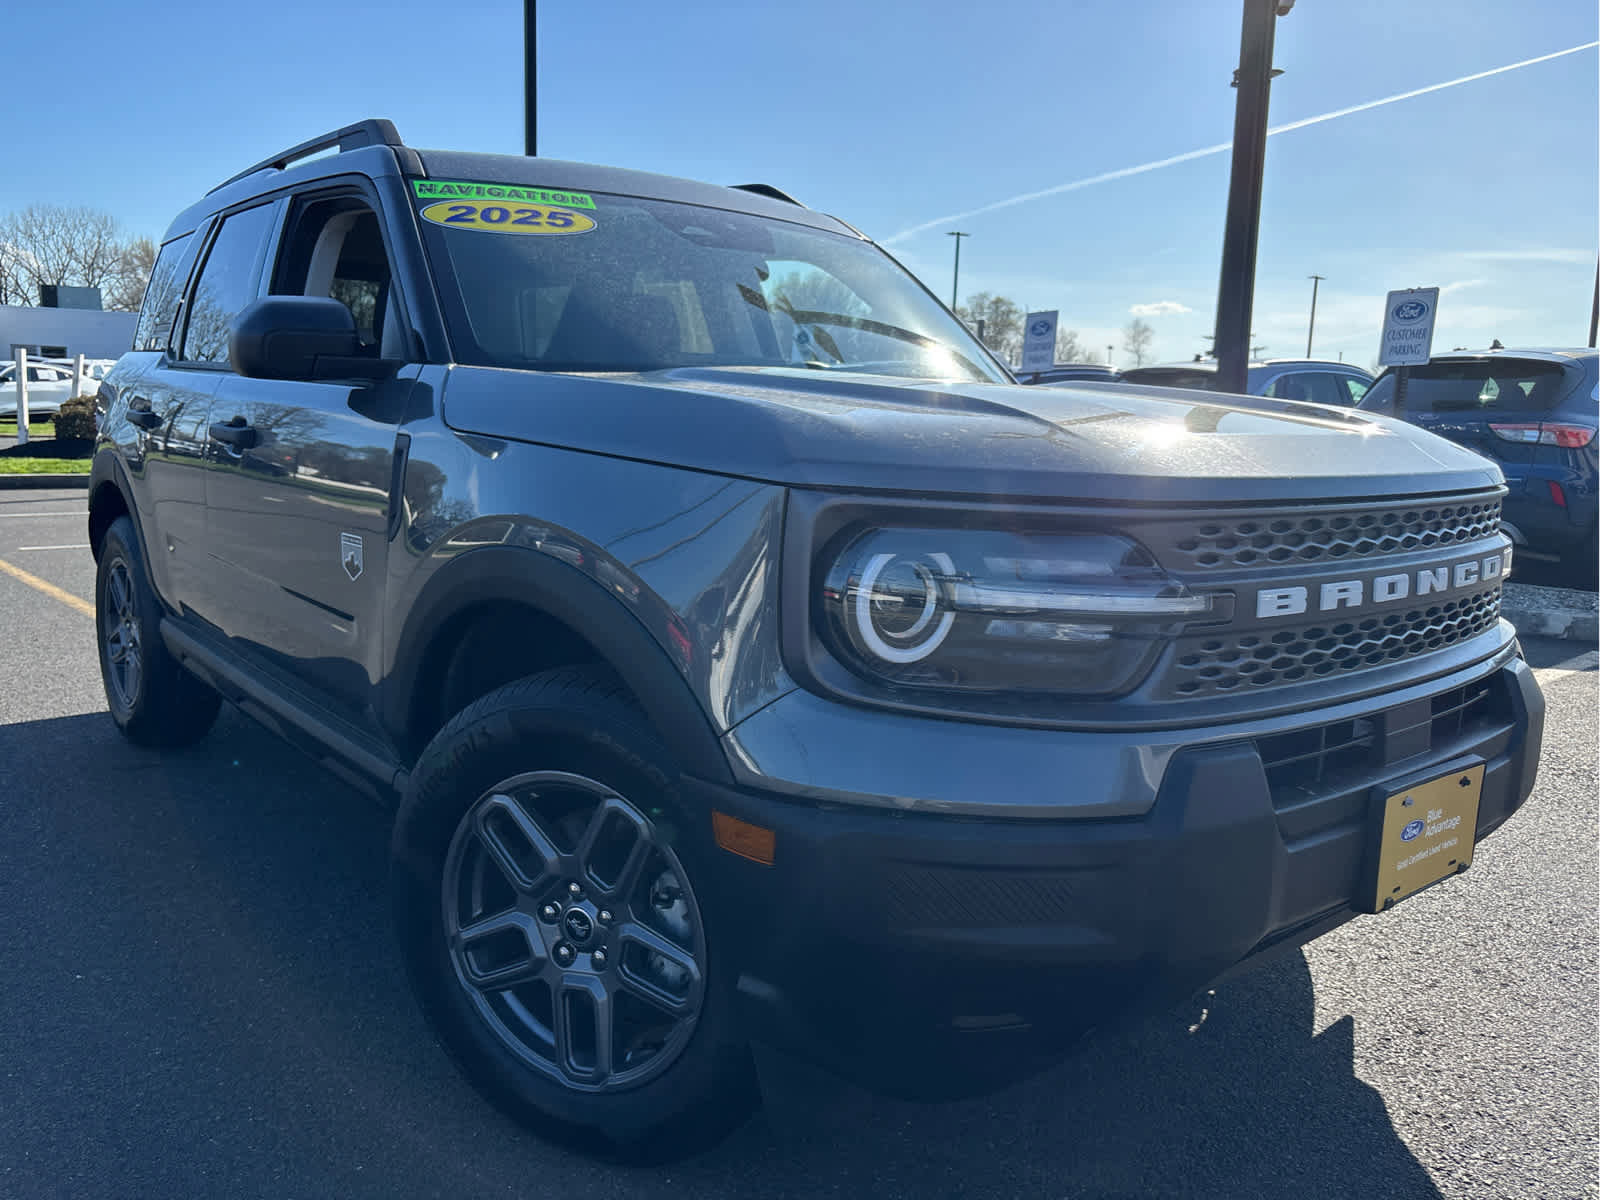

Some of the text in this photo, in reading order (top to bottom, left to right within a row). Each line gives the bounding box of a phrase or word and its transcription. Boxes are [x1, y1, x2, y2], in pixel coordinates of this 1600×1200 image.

[418, 183, 587, 205] NAVIGATION
[444, 205, 575, 228] 2025
[1387, 327, 1426, 342] CUSTOMER
[1388, 343, 1421, 356] PARKING
[1256, 554, 1501, 619] BRONCO
[1426, 808, 1442, 823] Blue
[1403, 821, 1422, 840] Ford
[1425, 815, 1461, 838] Advantage
